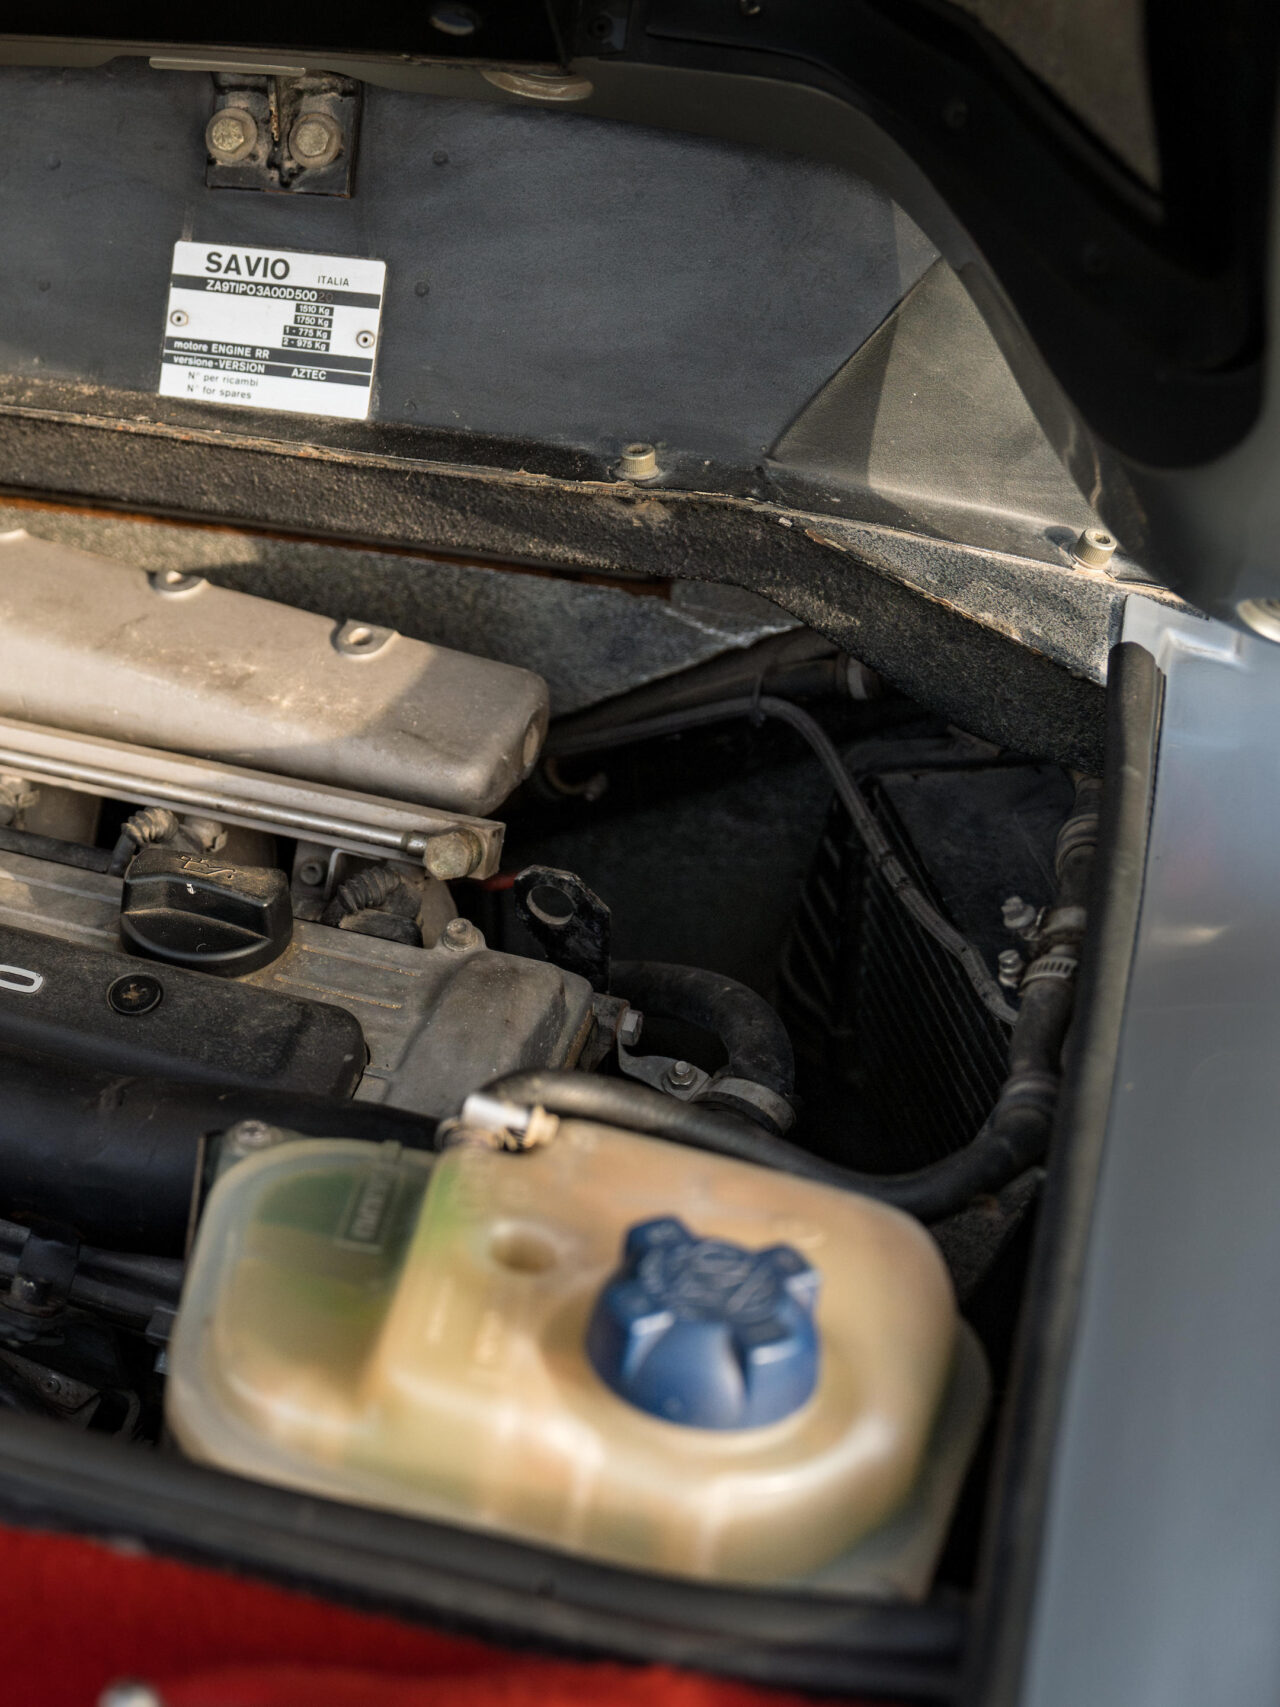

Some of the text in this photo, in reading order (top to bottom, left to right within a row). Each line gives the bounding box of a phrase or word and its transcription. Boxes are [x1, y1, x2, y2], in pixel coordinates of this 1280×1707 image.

[205, 252, 290, 280] SAVIO
[317, 275, 350, 287] ITALIA
[319, 306, 330, 316] Kg
[318, 318, 329, 328] Kg
[316, 330, 328, 340] Kg
[174, 340, 270, 359] motore ENGINE RR
[315, 341, 326, 351] Kg
[291, 368, 327, 380] AZTEC
[203, 374, 219, 384] per
[222, 376, 259, 387] ricambi
[203, 386, 216, 395] for
[219, 388, 252, 399] spares
